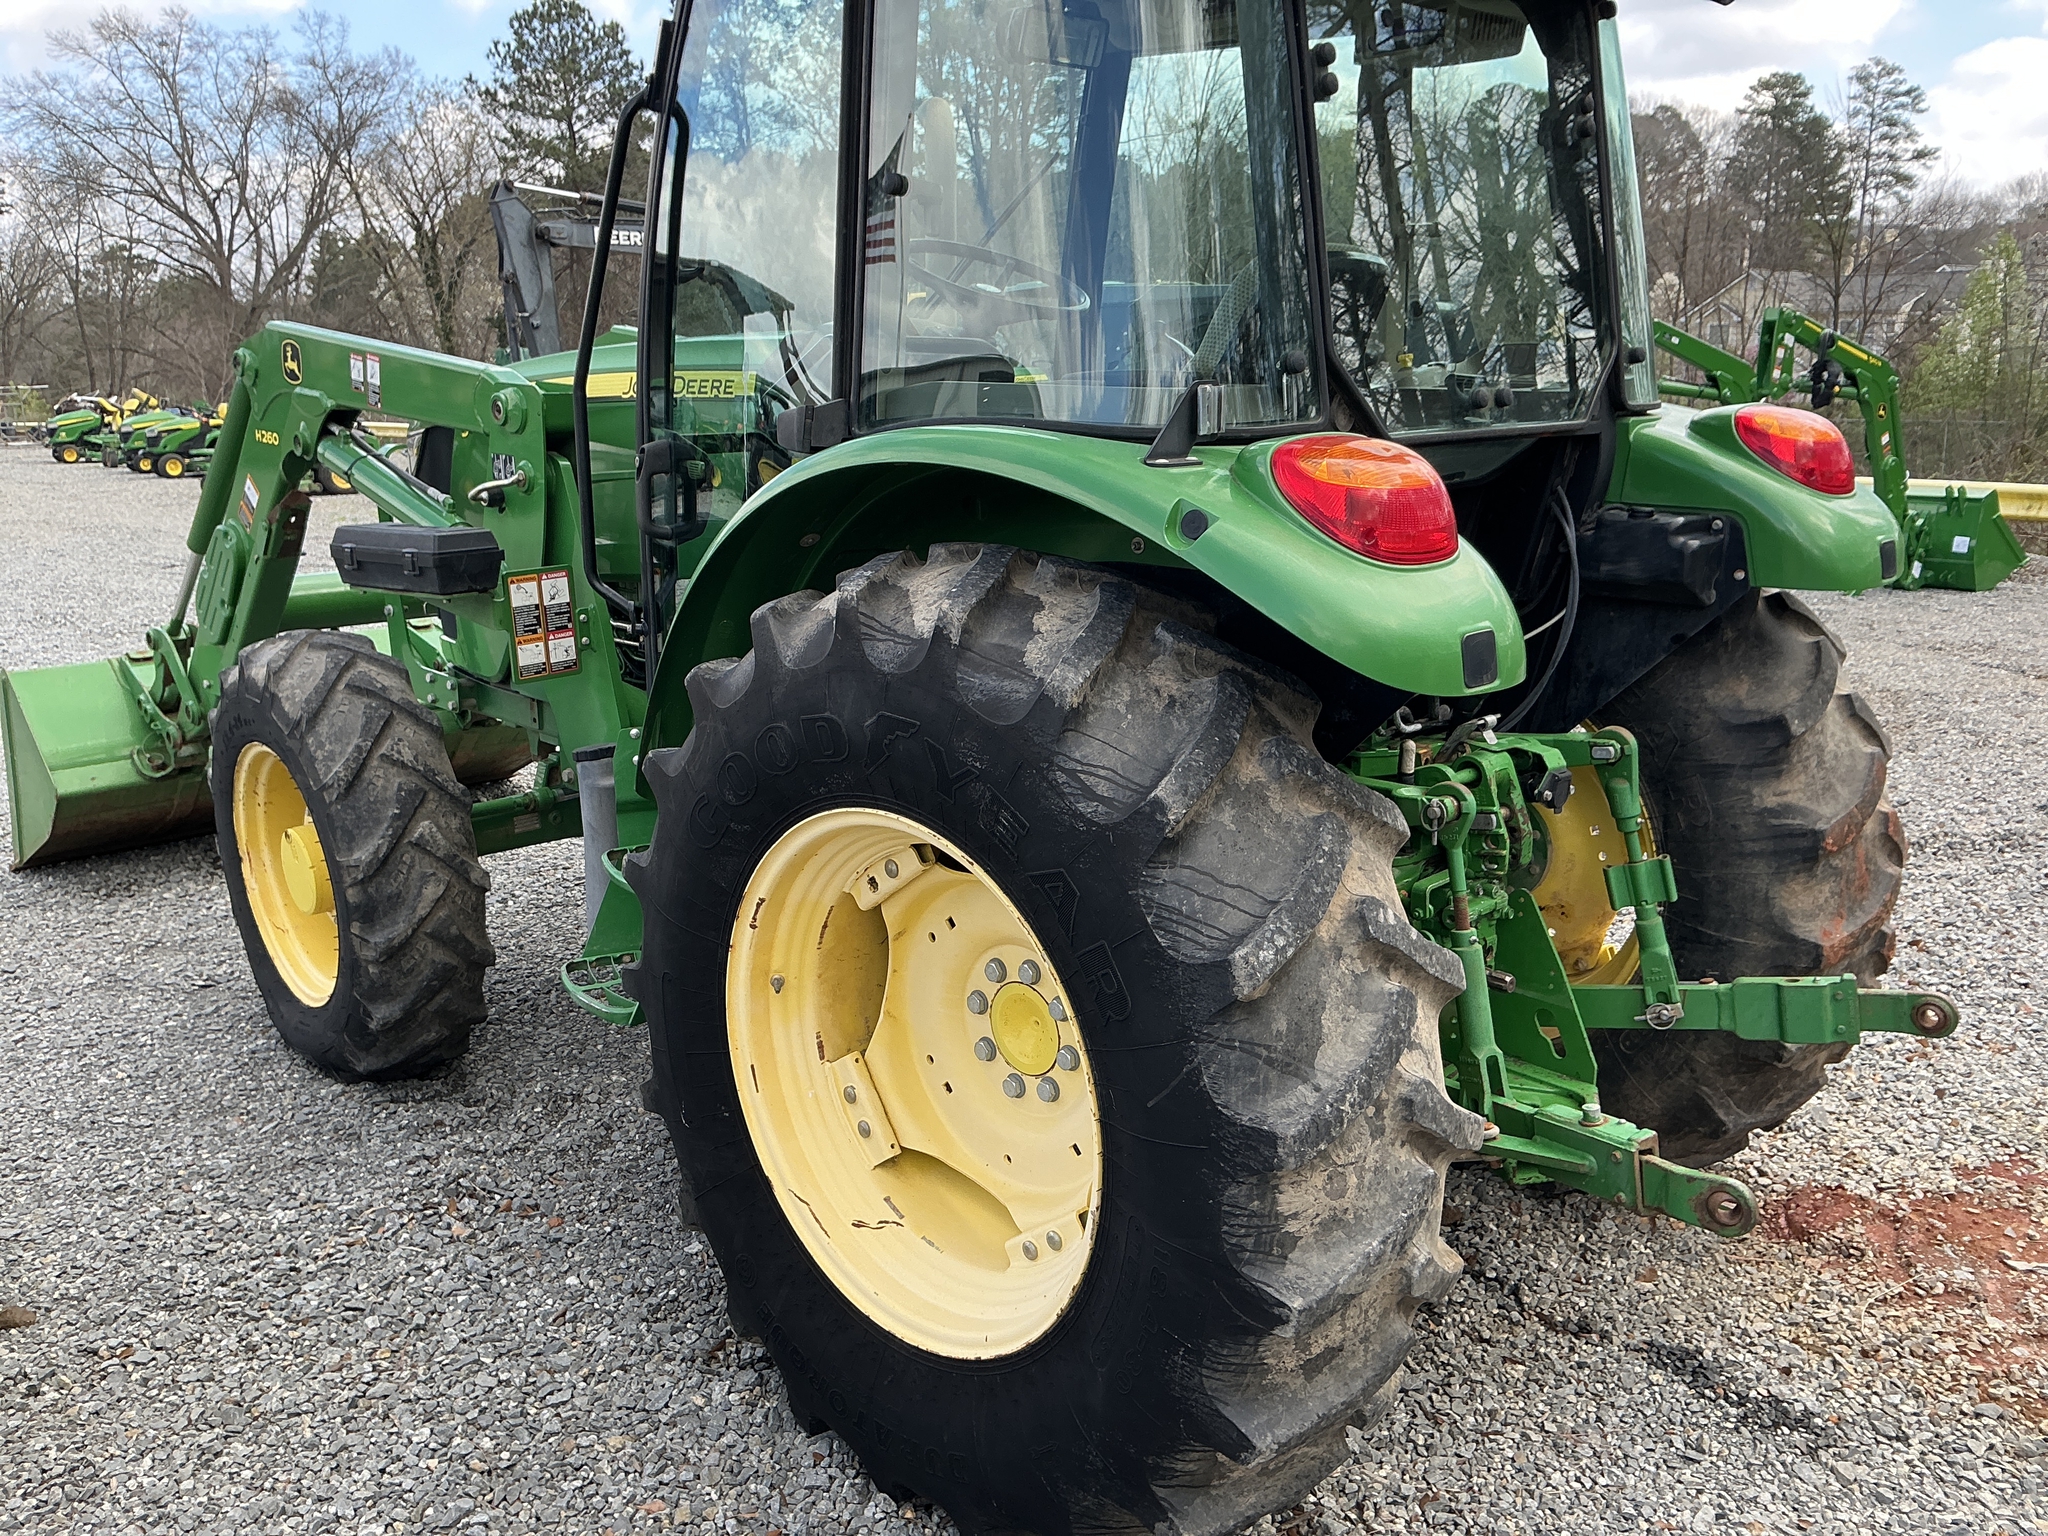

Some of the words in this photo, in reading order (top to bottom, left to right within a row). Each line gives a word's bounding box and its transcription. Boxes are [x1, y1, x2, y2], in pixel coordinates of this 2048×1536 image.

[593, 226, 645, 246] EER
[672, 376, 735, 396] DEERE
[255, 429, 280, 446] H260
[547, 571, 567, 579] DANGER
[554, 631, 573, 639] DANGER
[689, 711, 1132, 1026] GOODYEAR
